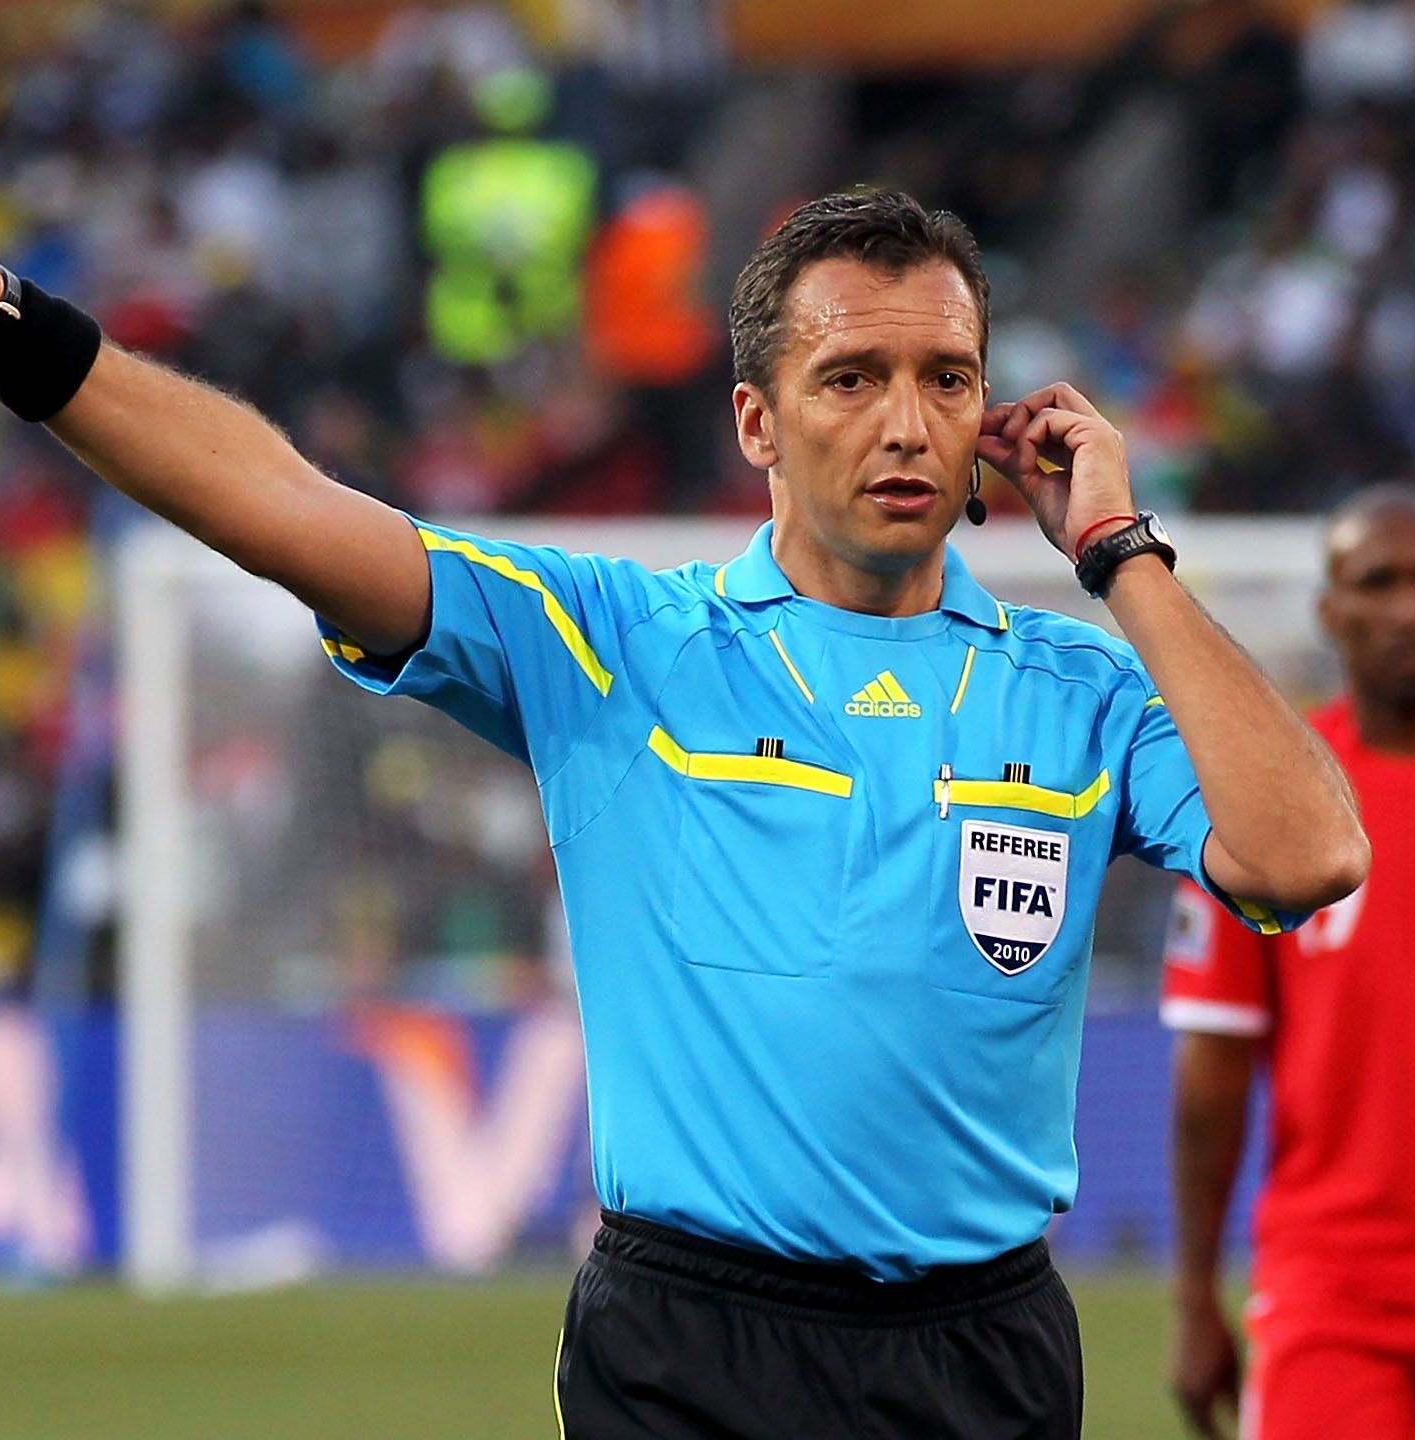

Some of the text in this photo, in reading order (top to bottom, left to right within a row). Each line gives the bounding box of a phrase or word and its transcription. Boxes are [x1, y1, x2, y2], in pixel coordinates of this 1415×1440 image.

[844, 700, 922, 718] adidas
[970, 831, 1062, 862] REFEREE
[973, 876, 1055, 918] FIFA
[992, 942, 1031, 973] 2010
